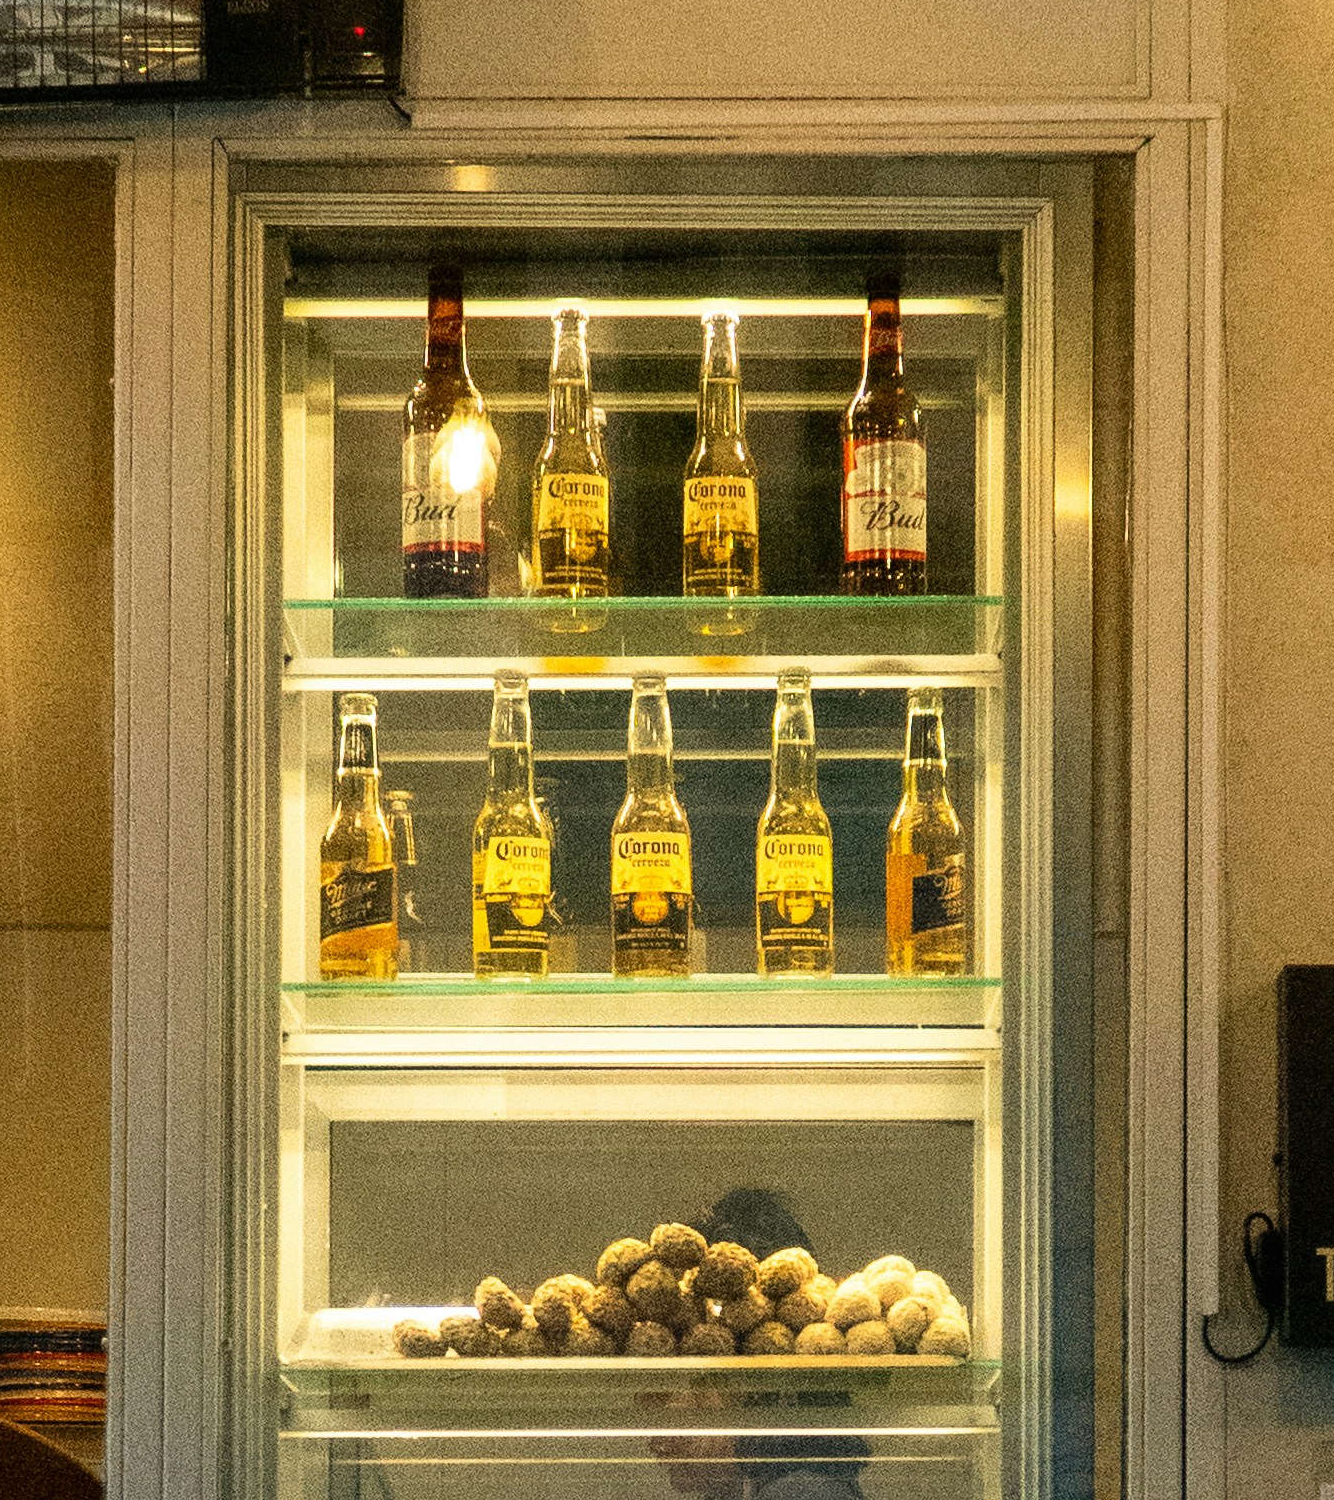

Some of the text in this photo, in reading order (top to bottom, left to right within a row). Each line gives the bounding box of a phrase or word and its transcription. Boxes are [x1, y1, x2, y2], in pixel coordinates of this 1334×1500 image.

[548, 477, 606, 499] Corona
[688, 481, 747, 503] Corona
[404, 492, 460, 525] Bud
[860, 499, 925, 531] Bud
[618, 837, 681, 860] Corona
[764, 838, 825, 860] Corona
